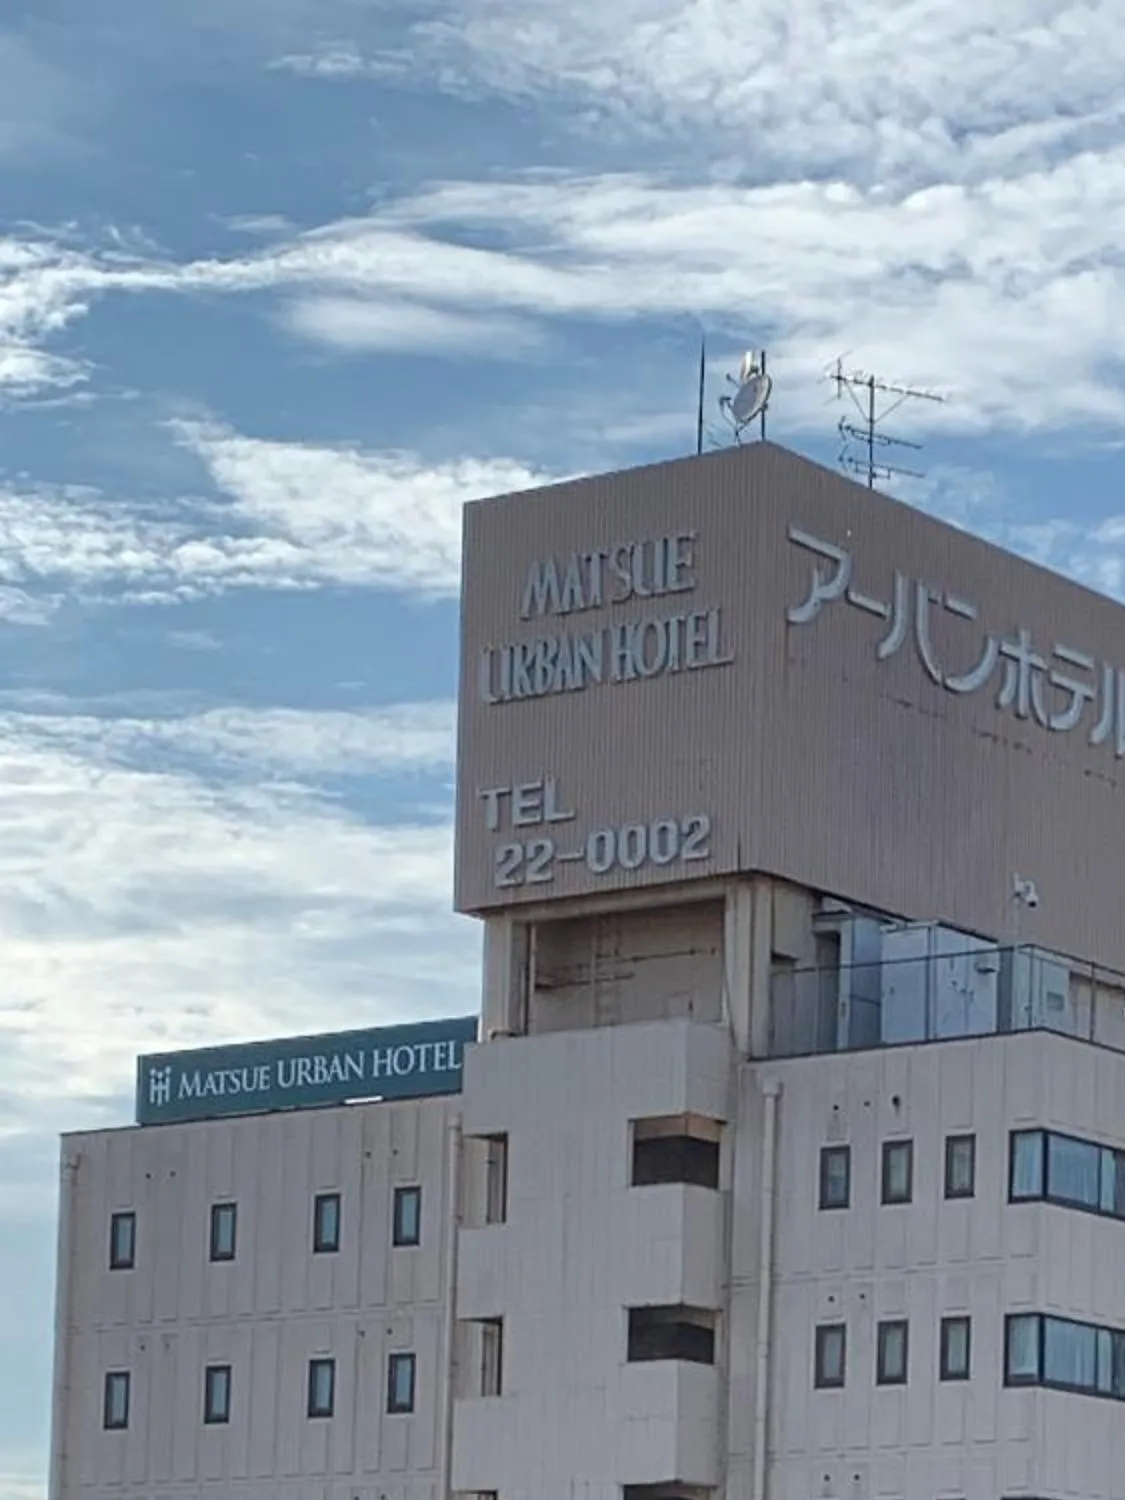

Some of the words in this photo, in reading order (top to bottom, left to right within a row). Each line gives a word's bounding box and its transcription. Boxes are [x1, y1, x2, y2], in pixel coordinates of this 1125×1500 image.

[521, 530, 697, 621] MATSUE
[482, 629, 606, 706] URBAN
[608, 607, 735, 687] HOTEL
[479, 776, 575, 832] TEL
[495, 815, 711, 889] 22-0002
[177, 1065, 271, 1099] MATSUE
[276, 1051, 365, 1089] URBAN
[372, 1040, 463, 1079] HOTEL
